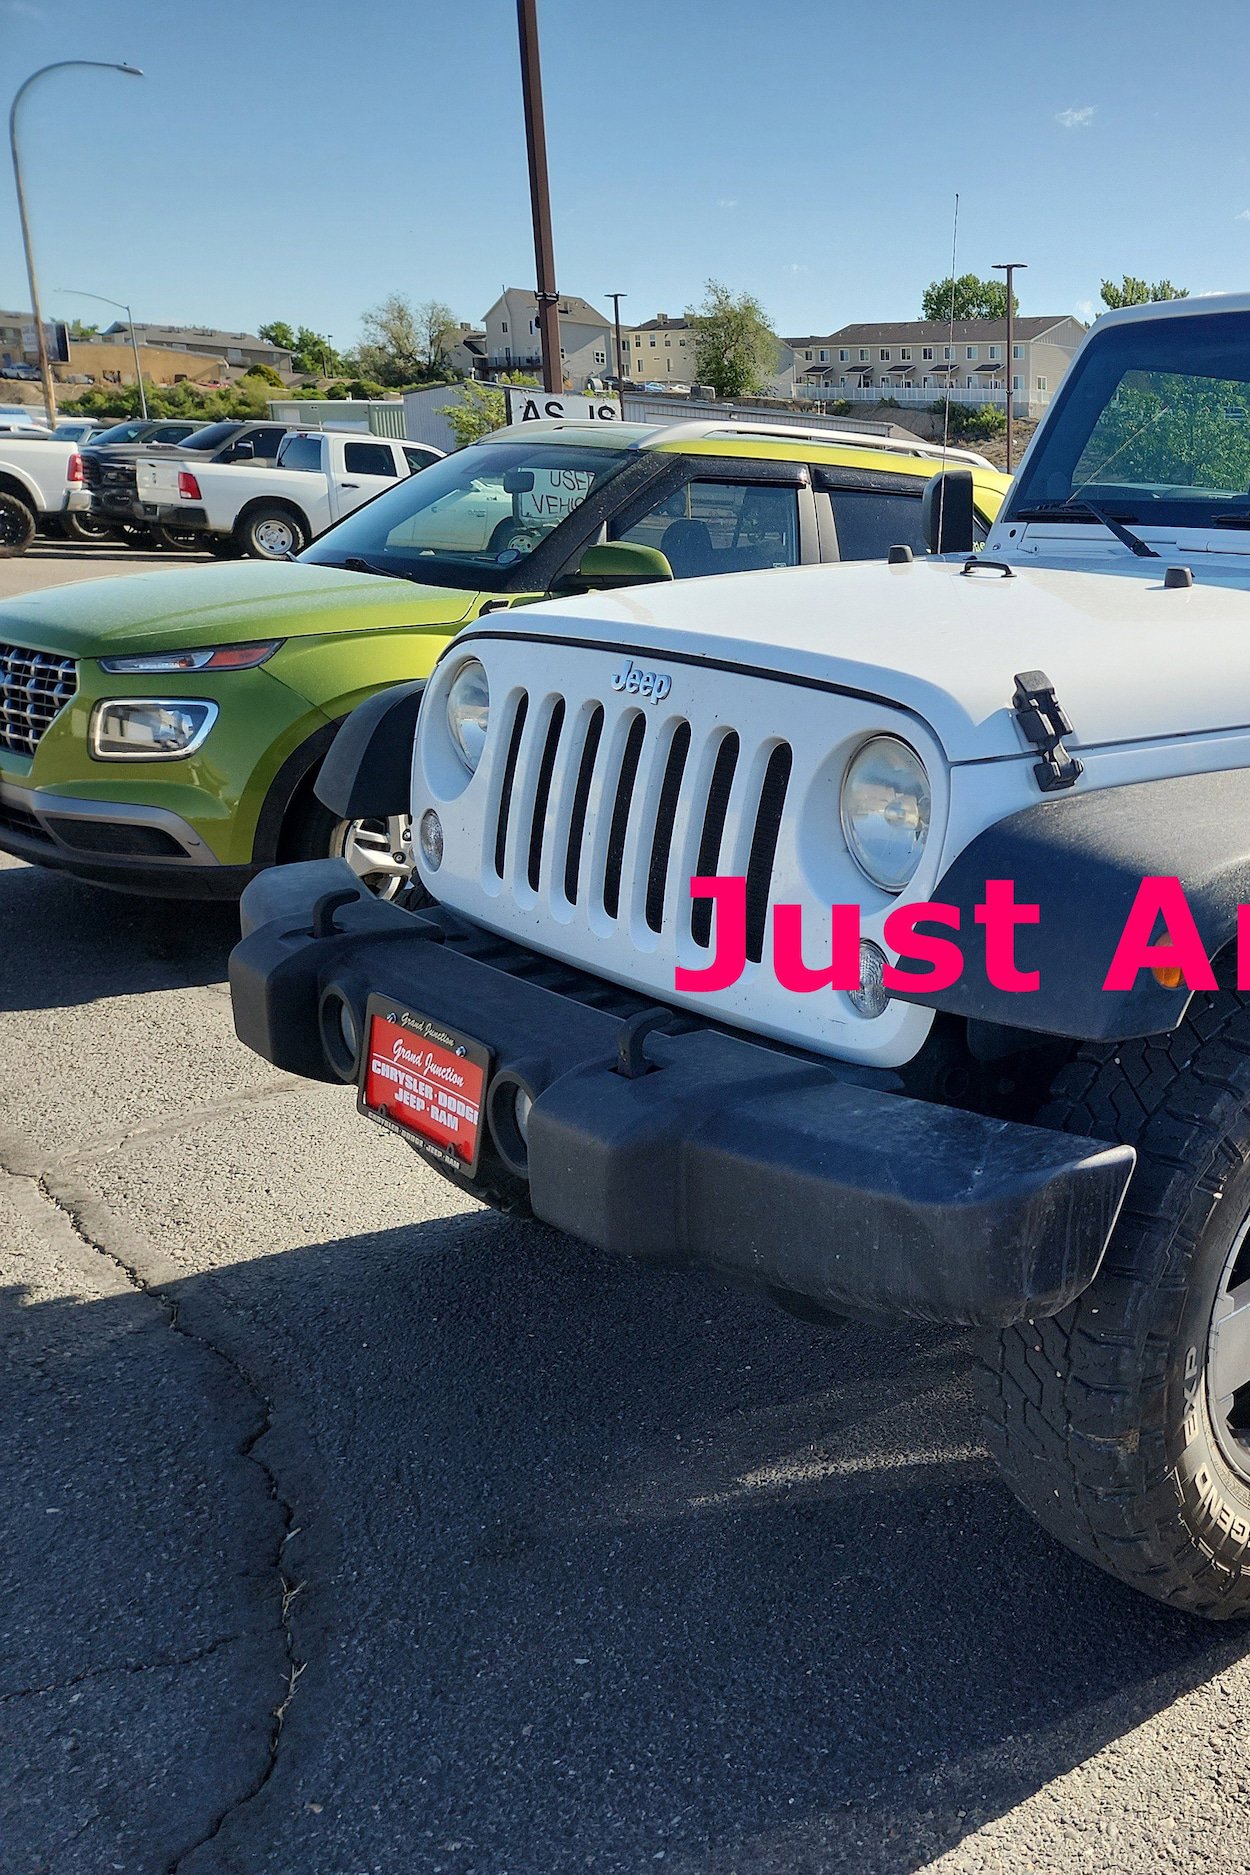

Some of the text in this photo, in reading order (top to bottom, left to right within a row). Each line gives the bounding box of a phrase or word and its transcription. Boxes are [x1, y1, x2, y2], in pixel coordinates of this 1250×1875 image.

[521, 400, 616, 421] AS IS
[610, 660, 672, 705] Jeep
[401, 1012, 455, 1047] Grand Junction
[371, 1059, 433, 1100] CHRYSLER
[393, 1039, 465, 1087] Grand Junction
[394, 1088, 459, 1132] JEEP RAM
[1183, 1346, 1198, 1447] EXP
